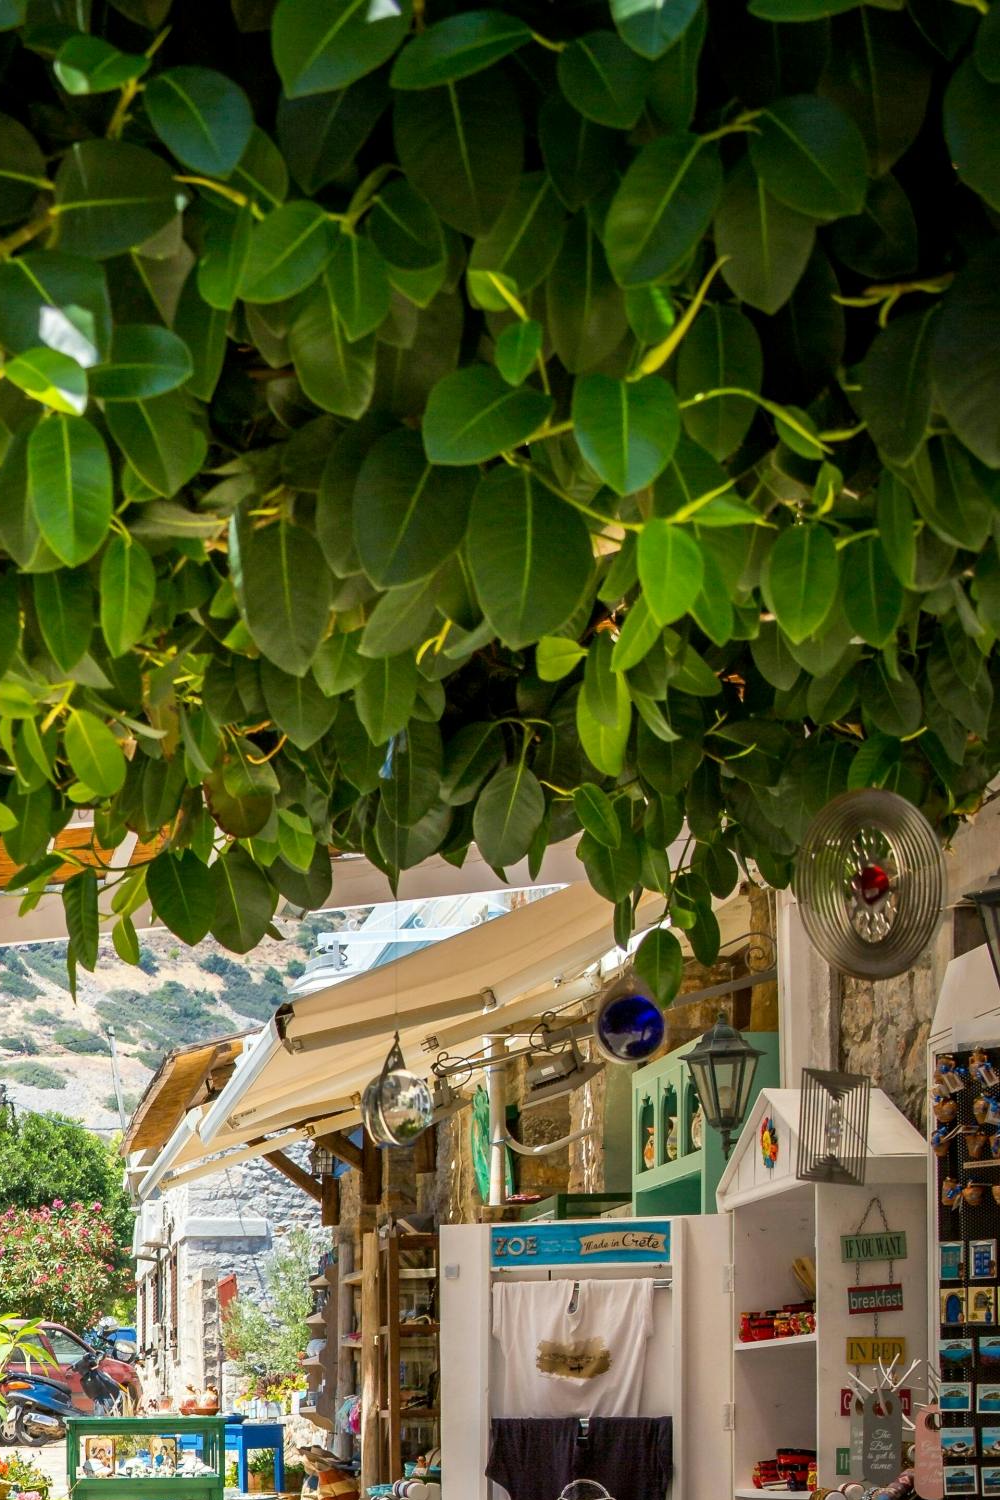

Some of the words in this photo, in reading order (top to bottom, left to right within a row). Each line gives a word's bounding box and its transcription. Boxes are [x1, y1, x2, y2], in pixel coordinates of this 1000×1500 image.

[494, 1236, 537, 1256] ZOE
[584, 1239, 609, 1251] Made
[611, 1239, 620, 1247] in
[622, 1233, 660, 1248] Crete
[845, 1240, 854, 1259] IF
[855, 1238, 874, 1258] YOU
[875, 1236, 902, 1257] WANT
[850, 1289, 902, 1310] breakfast
[849, 1342, 868, 1360] IN
[871, 1342, 903, 1360] BED
[872, 1429, 891, 1439] The
[870, 1441, 893, 1451] Best
